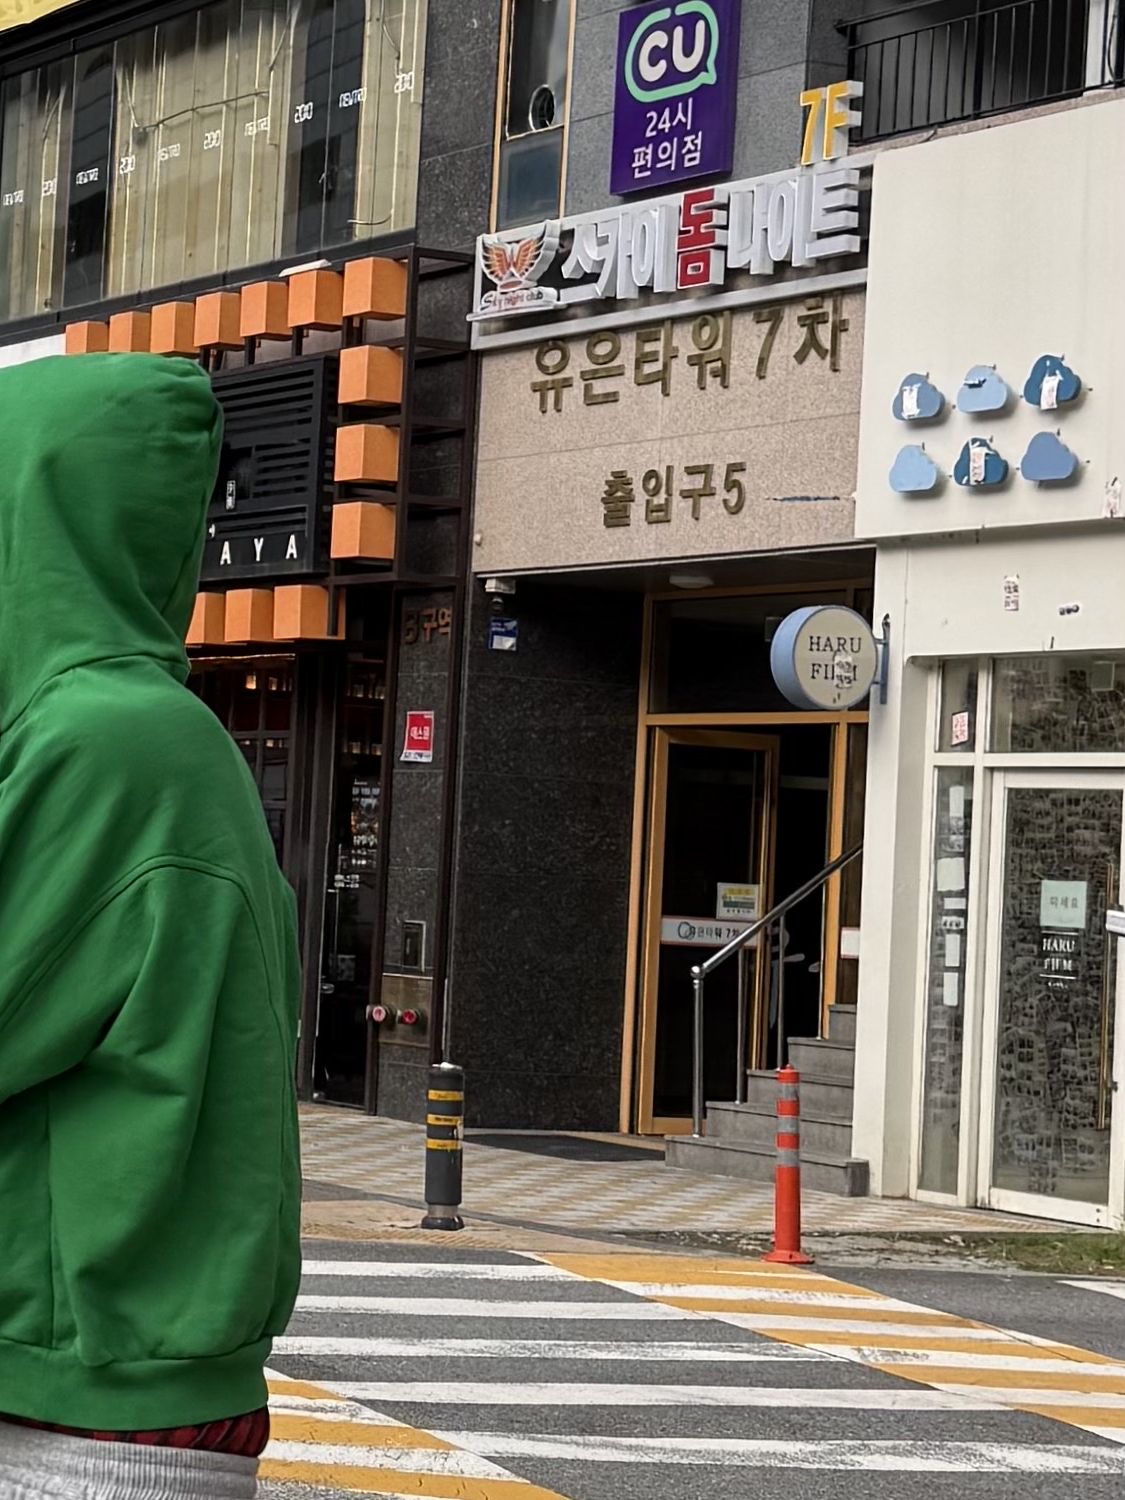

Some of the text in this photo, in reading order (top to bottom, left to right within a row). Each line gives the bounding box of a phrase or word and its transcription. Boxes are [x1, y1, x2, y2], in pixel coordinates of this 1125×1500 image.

[639, 19, 706, 82] CU
[645, 97, 693, 138] 24시
[800, 80, 857, 166] 7F
[632, 131, 703, 179] 편의점
[560, 169, 860, 300] 스카이돔나이트
[531, 297, 850, 414] 유은타워 7차
[601, 462, 747, 528] 출입구5
[808, 635, 862, 653] HARU
